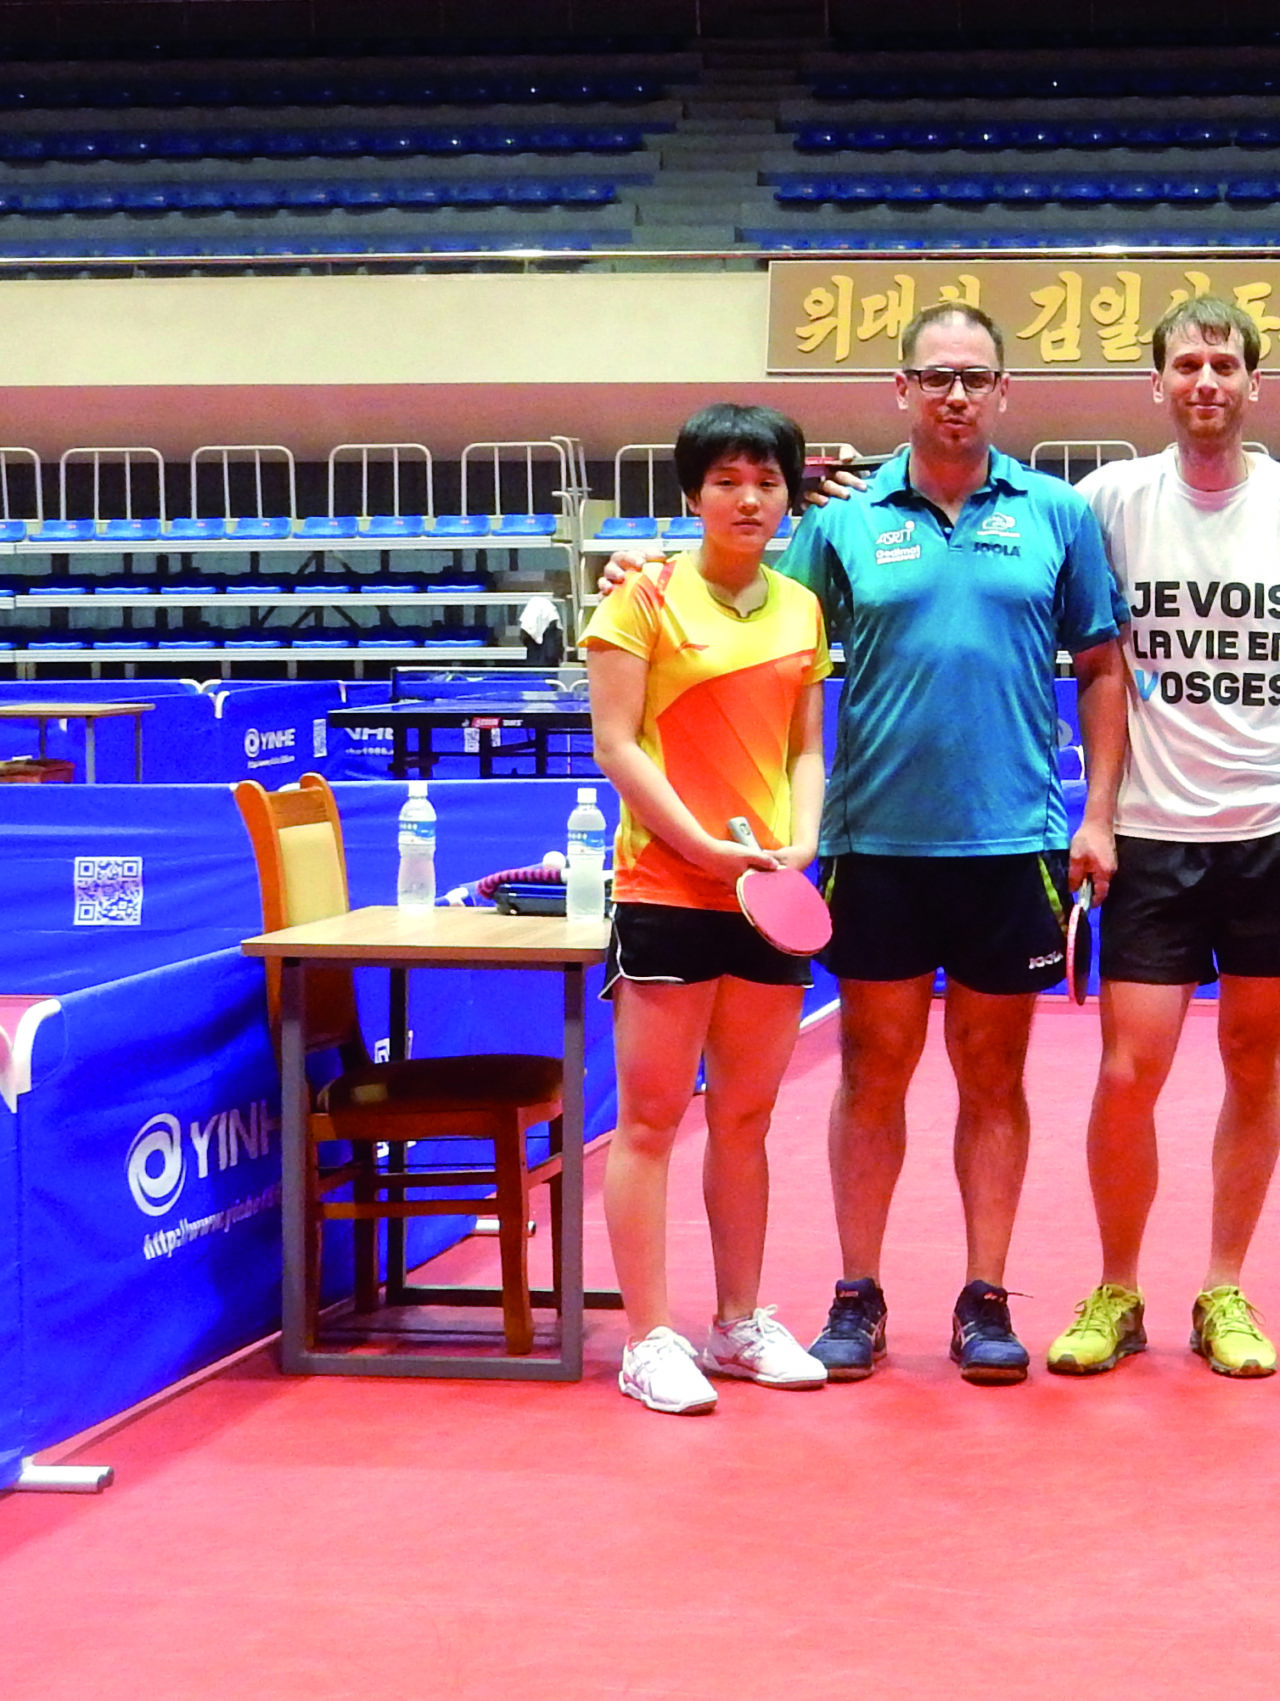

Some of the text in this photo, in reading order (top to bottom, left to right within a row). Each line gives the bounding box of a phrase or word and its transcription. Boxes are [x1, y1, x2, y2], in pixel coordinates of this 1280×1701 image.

[973, 541, 1021, 557] JOOLA
[1130, 581, 1181, 618] JE
[1132, 629, 1172, 660] LA
[1175, 629, 1239, 660] VIE
[189, 1099, 283, 1180] YINH
